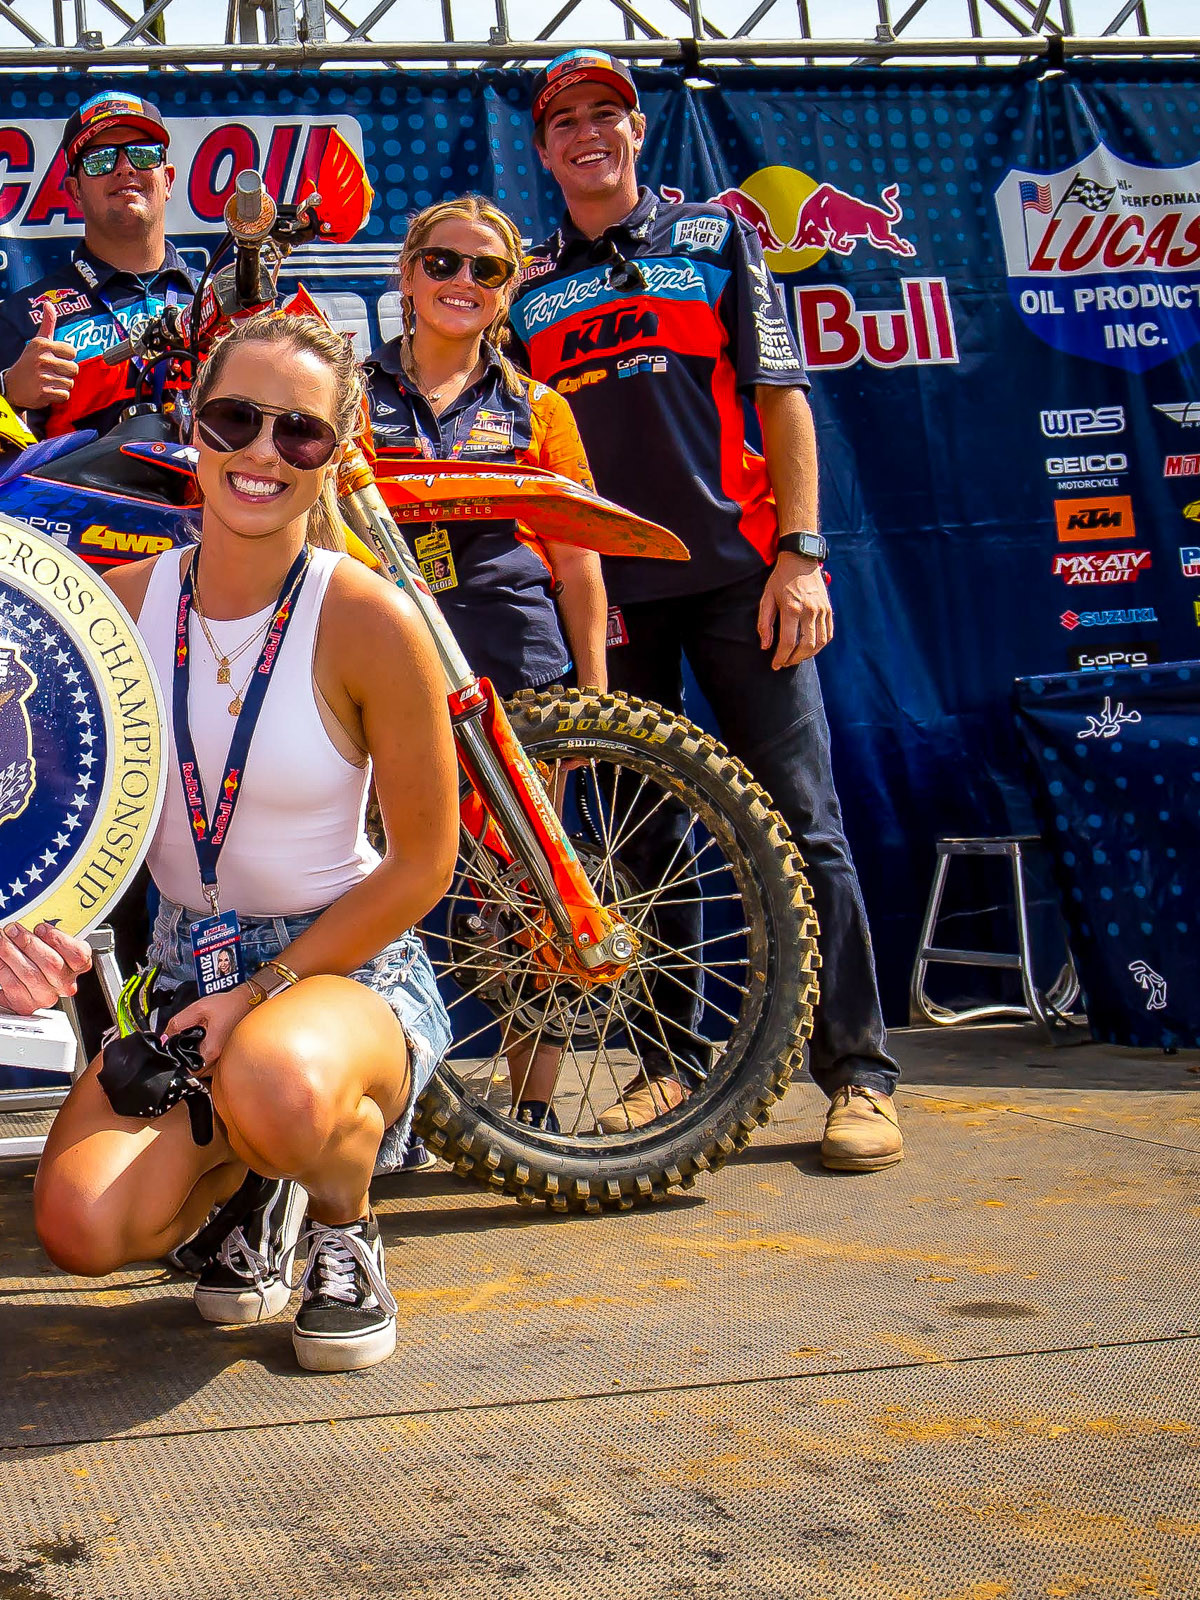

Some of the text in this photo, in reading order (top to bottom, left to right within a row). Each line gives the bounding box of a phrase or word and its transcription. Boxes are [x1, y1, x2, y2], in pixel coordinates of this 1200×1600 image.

[1121, 192, 1200, 207] PERFORMA
[678, 230, 721, 247] bakery
[1029, 212, 1200, 271] LUCAS
[60, 294, 92, 314] Bull
[1020, 284, 1200, 314] OIL PRODUCT
[561, 306, 659, 362] KTM
[794, 277, 960, 371] Bull
[1104, 322, 1169, 349] INC.
[617, 353, 668, 370] GoPro
[1040, 406, 1126, 437] WPS
[1046, 453, 1128, 475] GEICO
[1057, 478, 1119, 490] MOTORCYCLE
[14, 516, 72, 533] oPro
[393, 508, 420, 519] ACE
[1066, 508, 1123, 530] KTM
[366, 524, 386, 552] XACT
[1054, 551, 1150, 575] MX ATV
[1067, 569, 1133, 585] ALL OUT
[1079, 608, 1156, 627] SUZUKI
[1078, 651, 1148, 667] GoPro
[555, 718, 667, 745] DUNLOP
[74, 615, 153, 911] CHAMPIONSHIP
[182, 762, 202, 807] Red Bull
[211, 801, 233, 846] Red Bull
[200, 954, 215, 982] 2019
[205, 973, 240, 994] GUEST
